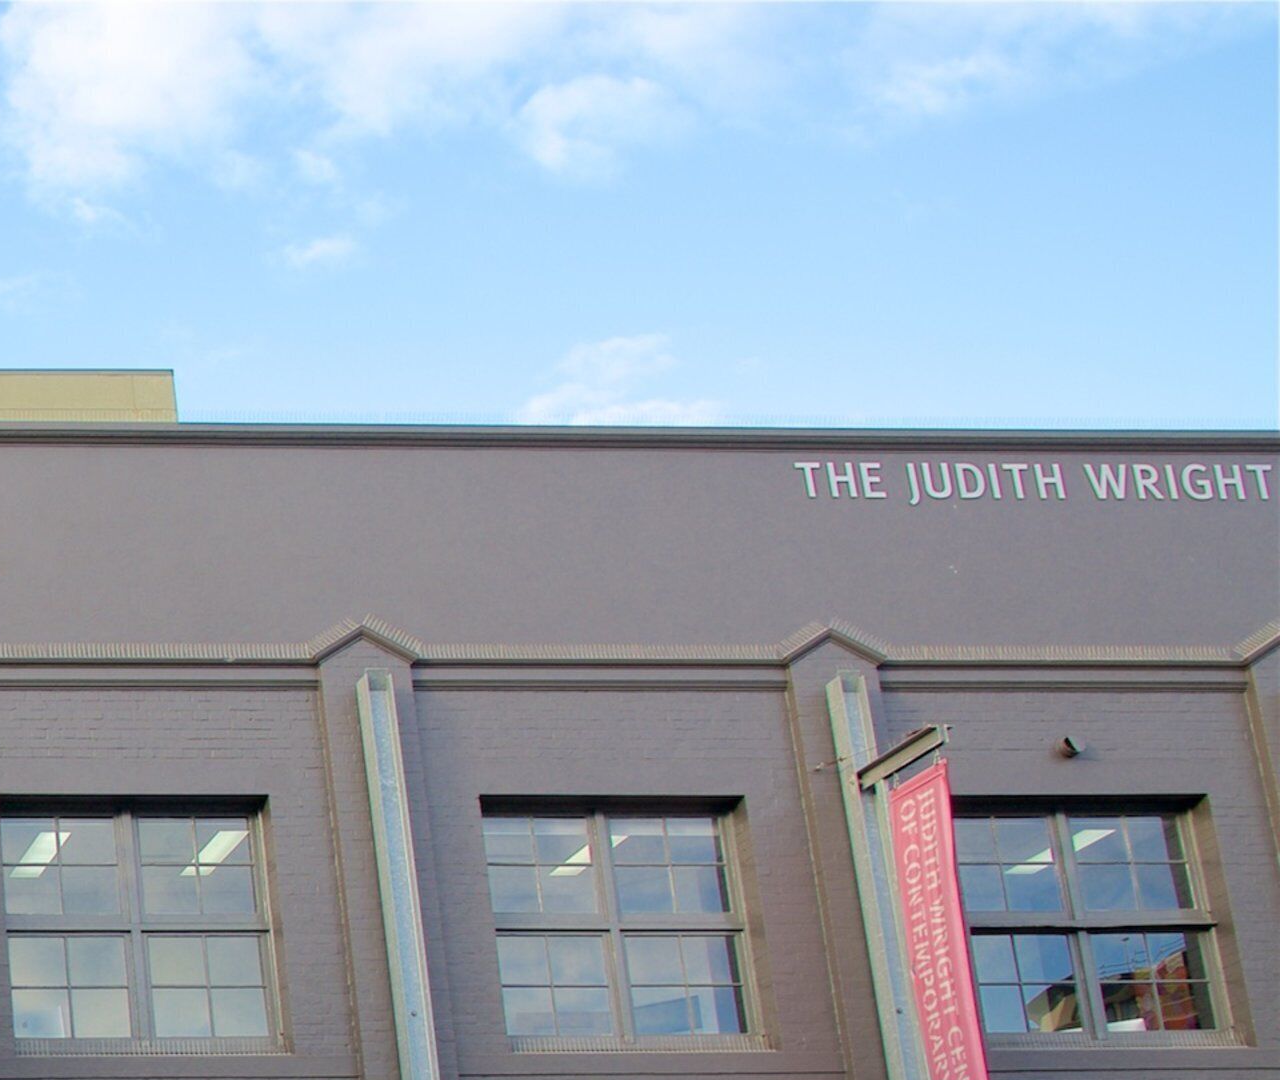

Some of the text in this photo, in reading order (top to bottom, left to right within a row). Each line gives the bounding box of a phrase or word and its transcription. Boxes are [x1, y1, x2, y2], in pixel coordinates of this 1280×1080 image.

[794, 462, 1272, 506] THE JUDITH WRIGHT
[899, 797, 921, 835] OF
[916, 788, 941, 890] JUDITH
[927, 896, 958, 1016] WRIGHT
